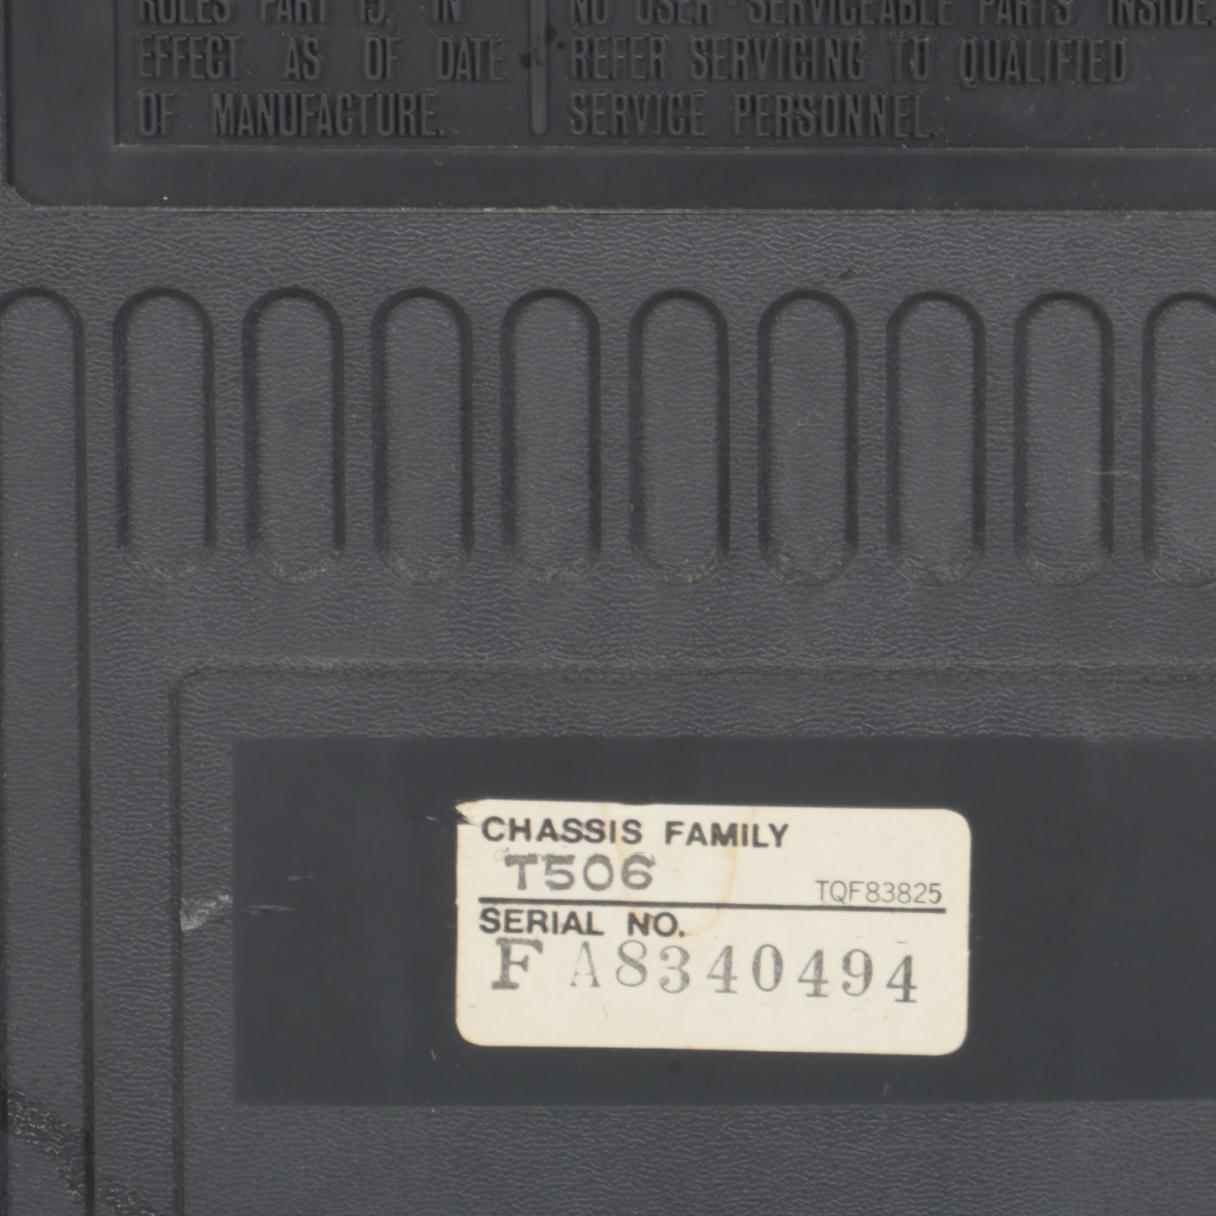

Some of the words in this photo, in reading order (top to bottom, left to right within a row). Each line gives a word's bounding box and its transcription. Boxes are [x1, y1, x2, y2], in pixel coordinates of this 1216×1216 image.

[137, 32, 242, 80] EFFECT
[283, 33, 323, 81] AS
[363, 34, 401, 81] OF
[436, 35, 505, 82] DATE
[568, 32, 669, 81] REFER
[689, 32, 869, 82] SERVICING
[888, 32, 933, 82] TO
[959, 33, 1130, 88] QUALIFIED
[137, 89, 176, 137] OF
[211, 89, 448, 138] MANUFACTURE.
[568, 88, 708, 136] SERVICE
[481, 815, 643, 845] CHASSIS
[664, 820, 789, 848] FAMILY
[504, 853, 656, 892] T506
[814, 879, 942, 905] TQF83825
[478, 907, 605, 936] SERIAL
[627, 911, 685, 938] NO.
